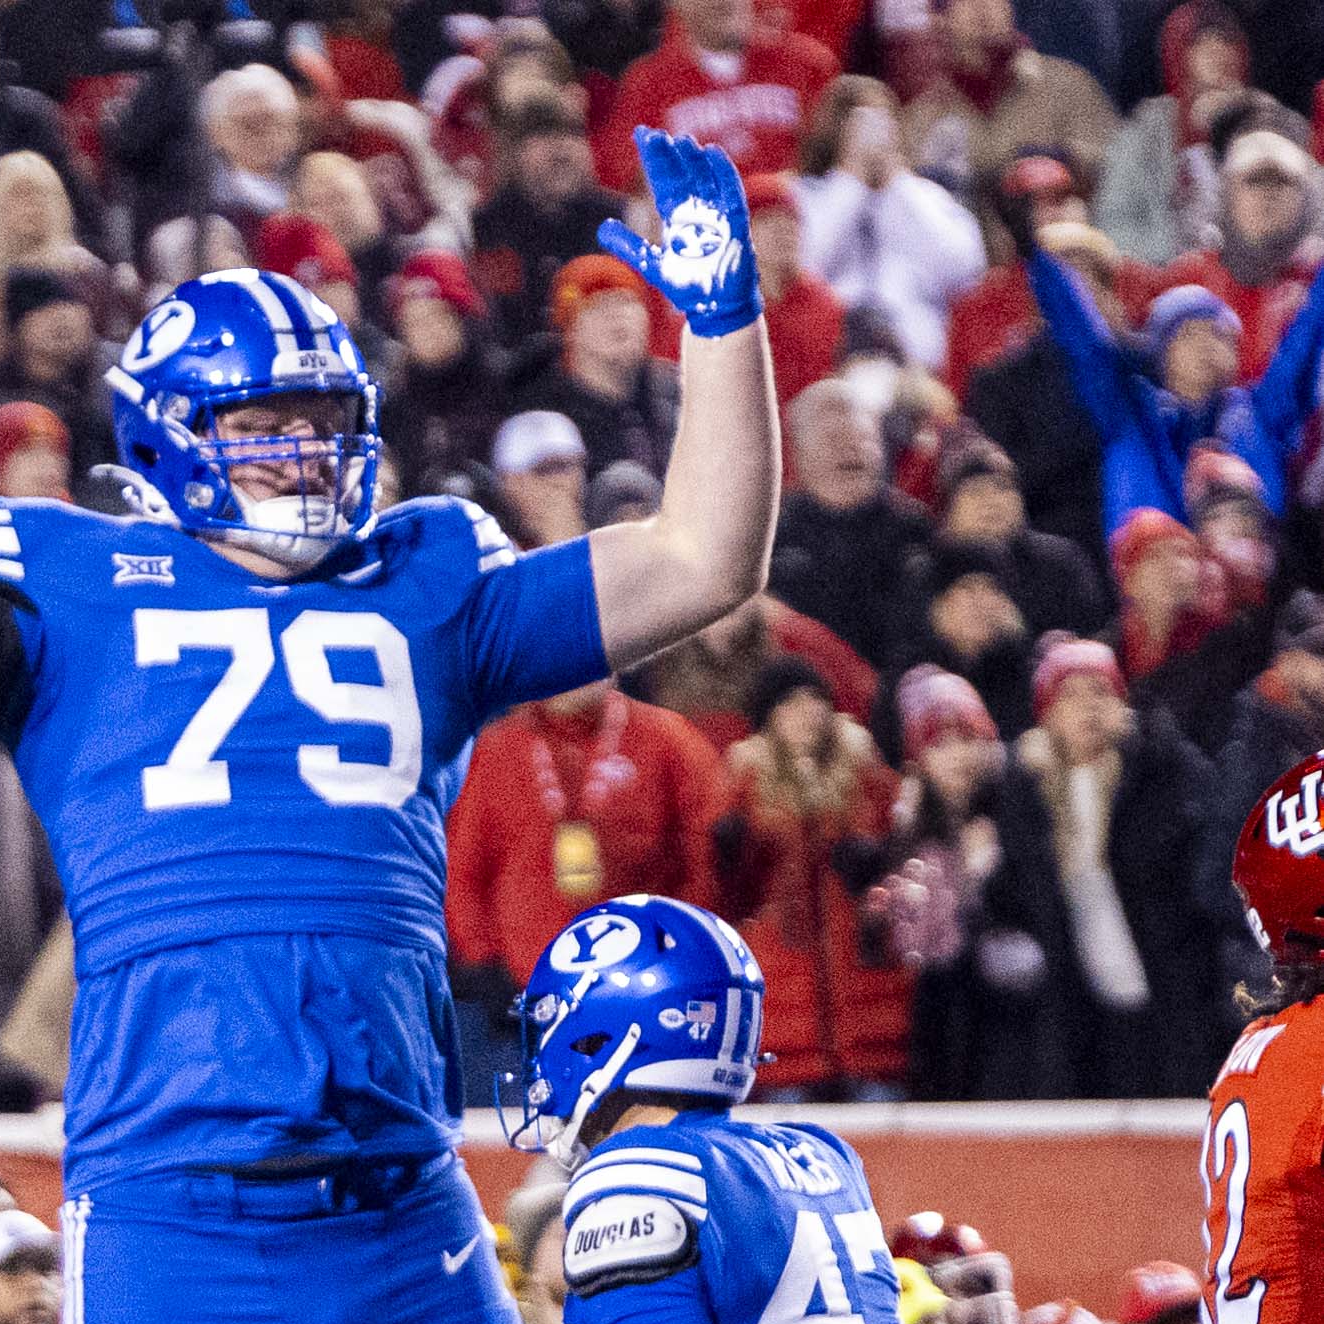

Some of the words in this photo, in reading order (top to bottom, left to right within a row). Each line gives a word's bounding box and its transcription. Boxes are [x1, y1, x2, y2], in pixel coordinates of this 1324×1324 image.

[134, 607, 422, 812] 79
[566, 918, 626, 963] Y
[689, 1022, 711, 1041] 47
[574, 1211, 656, 1255] DOUGLAS
